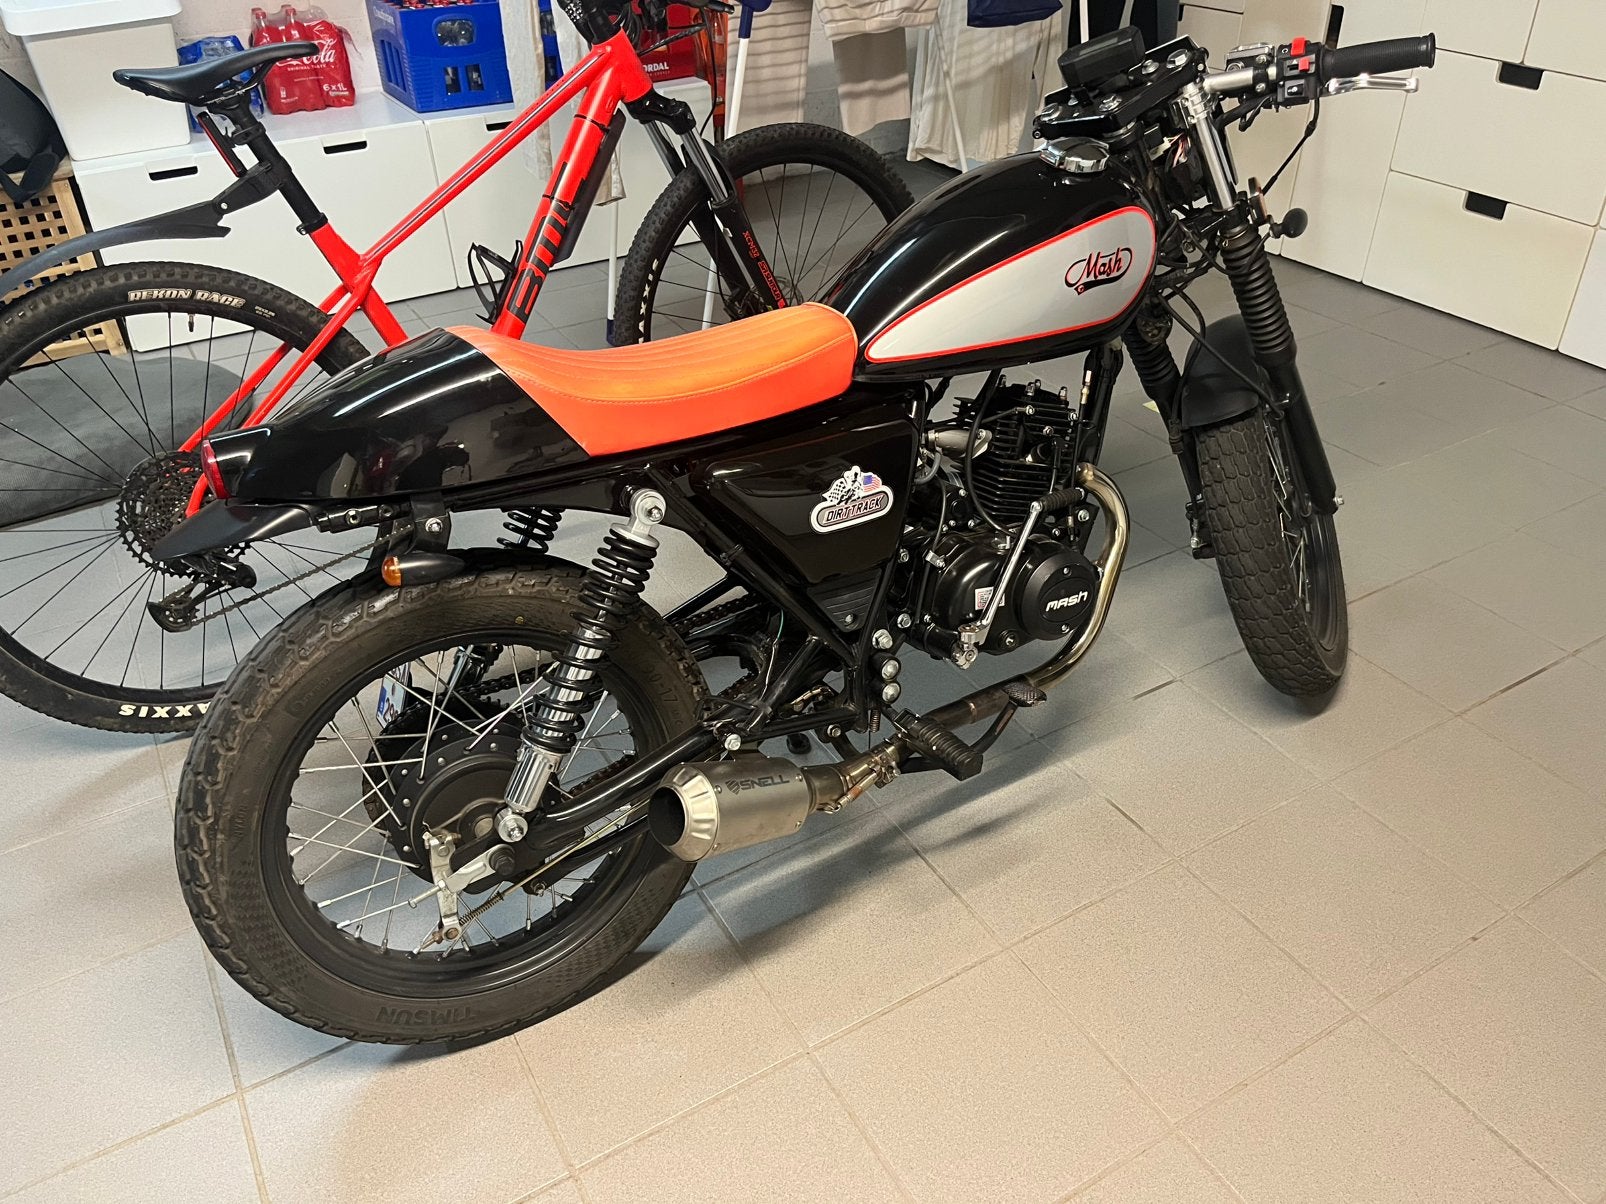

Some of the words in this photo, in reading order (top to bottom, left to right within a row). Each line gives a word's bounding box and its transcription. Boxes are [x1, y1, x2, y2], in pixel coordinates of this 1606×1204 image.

[1065, 247, 1125, 288] Mash
[128, 288, 192, 302] REKON
[195, 289, 246, 309] RACE
[638, 258, 659, 344] AXXIS
[118, 701, 212, 718] AXXIS
[740, 774, 790, 791] SNELL
